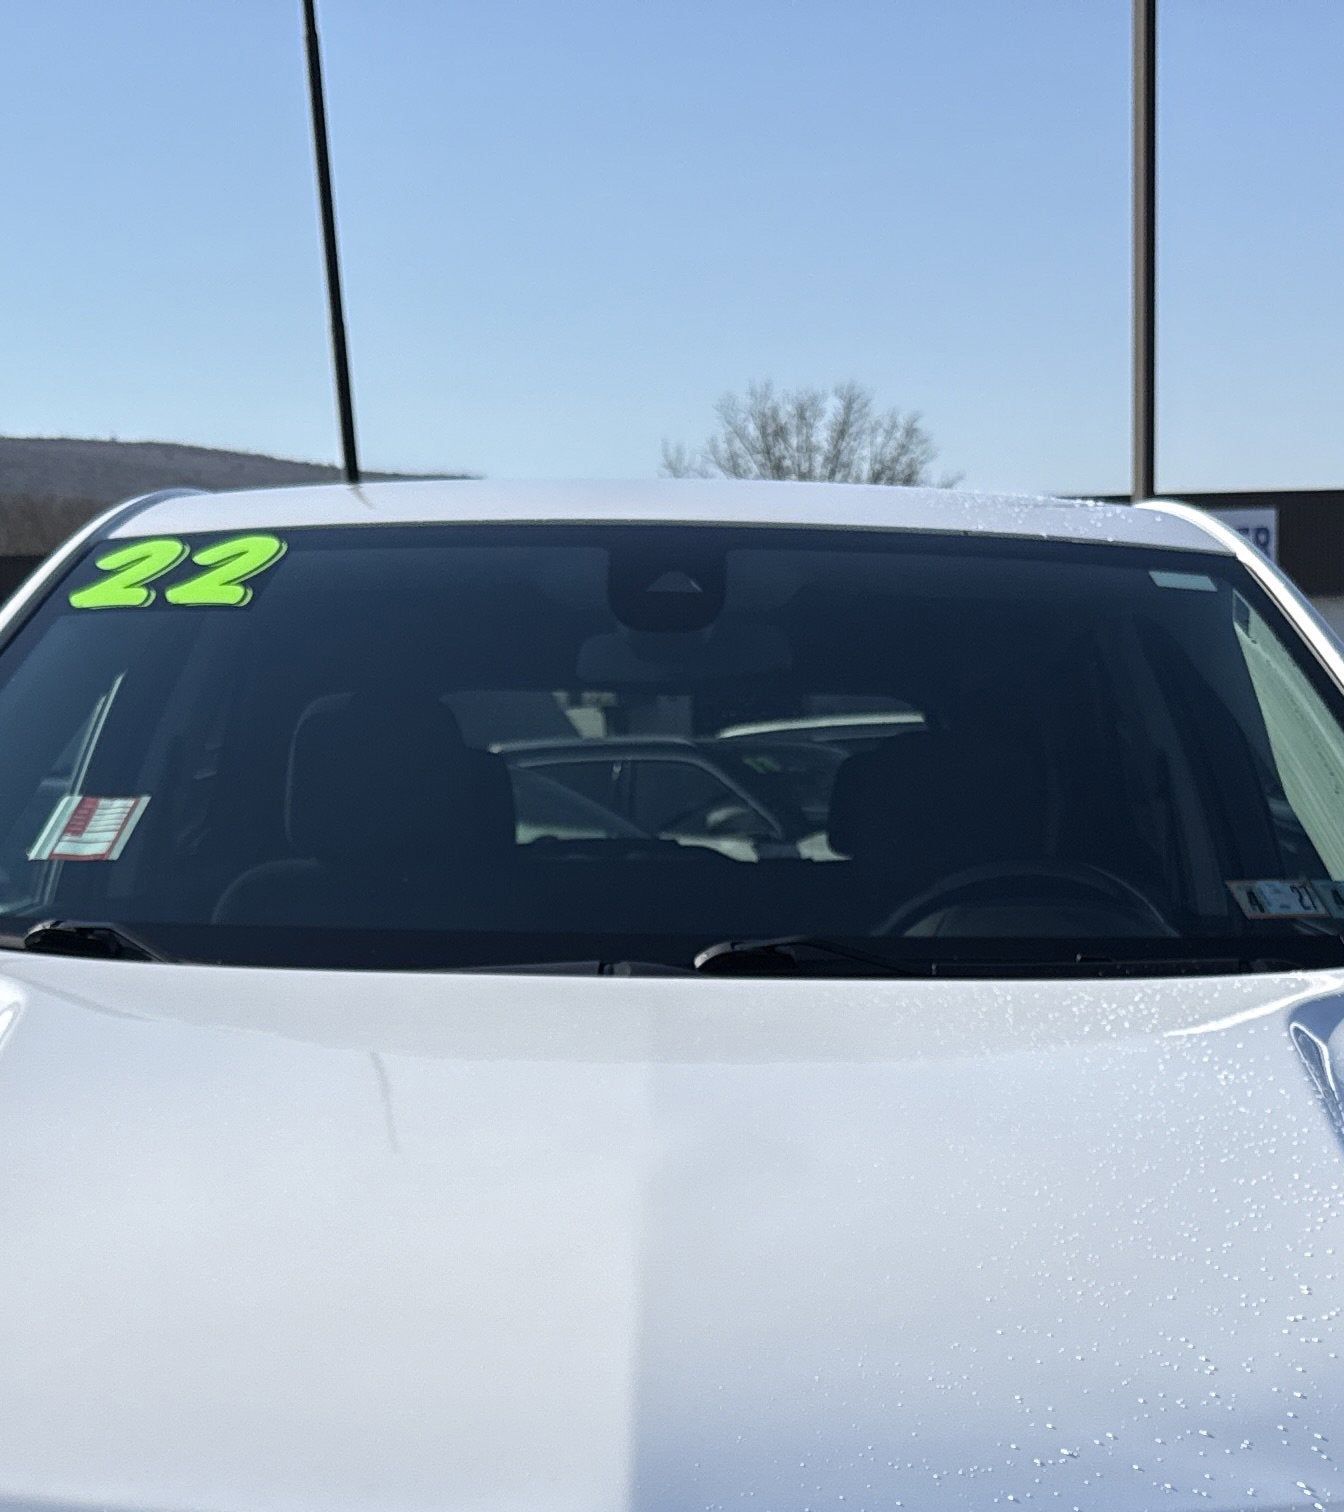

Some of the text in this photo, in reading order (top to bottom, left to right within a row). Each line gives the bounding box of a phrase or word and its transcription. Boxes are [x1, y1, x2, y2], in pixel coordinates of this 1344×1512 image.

[69, 536, 288, 609] 22
[1247, 888, 1265, 914] 4
[1289, 884, 1317, 911] 27
